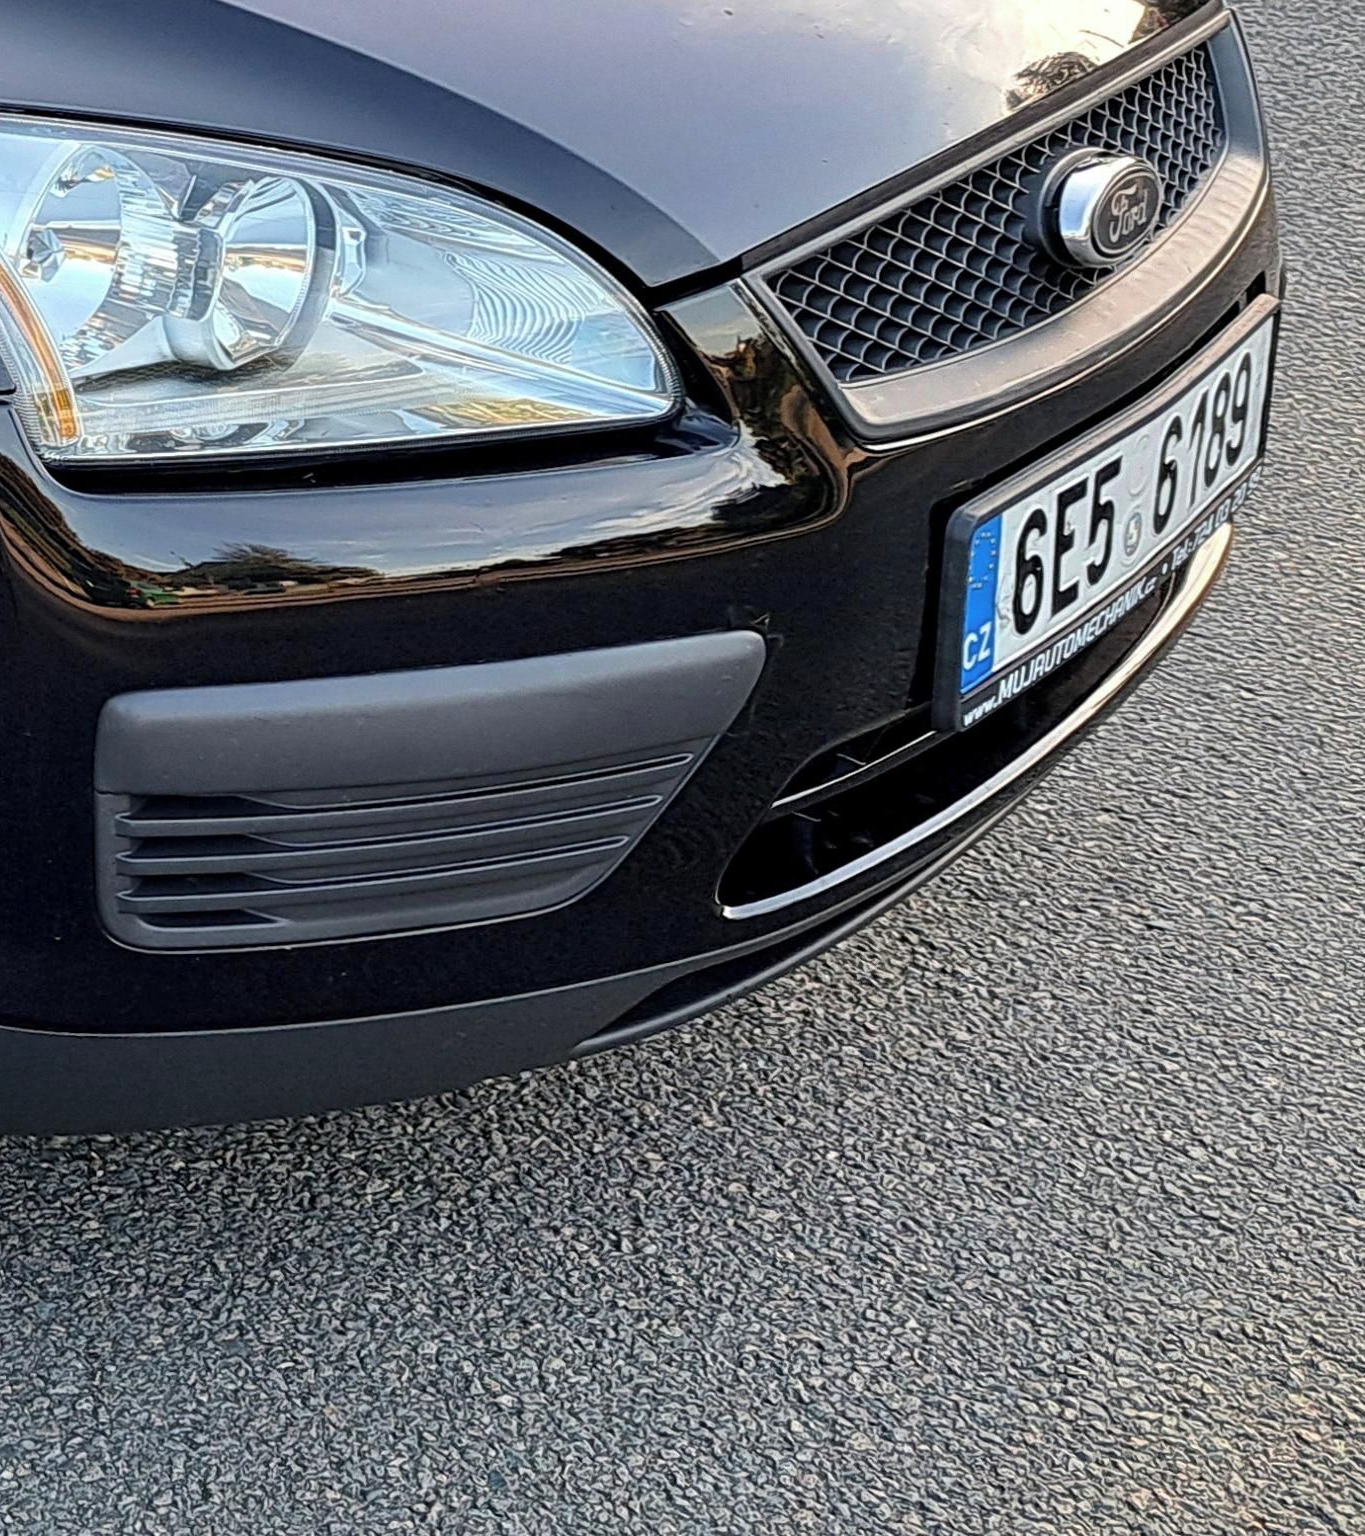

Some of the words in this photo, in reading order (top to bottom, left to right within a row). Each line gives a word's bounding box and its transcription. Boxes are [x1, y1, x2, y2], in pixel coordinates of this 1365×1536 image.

[1109, 183, 1149, 243] Ford
[1012, 452, 1125, 635] 6E5
[1151, 351, 1253, 535] 6189
[963, 621, 992, 670] CZ
